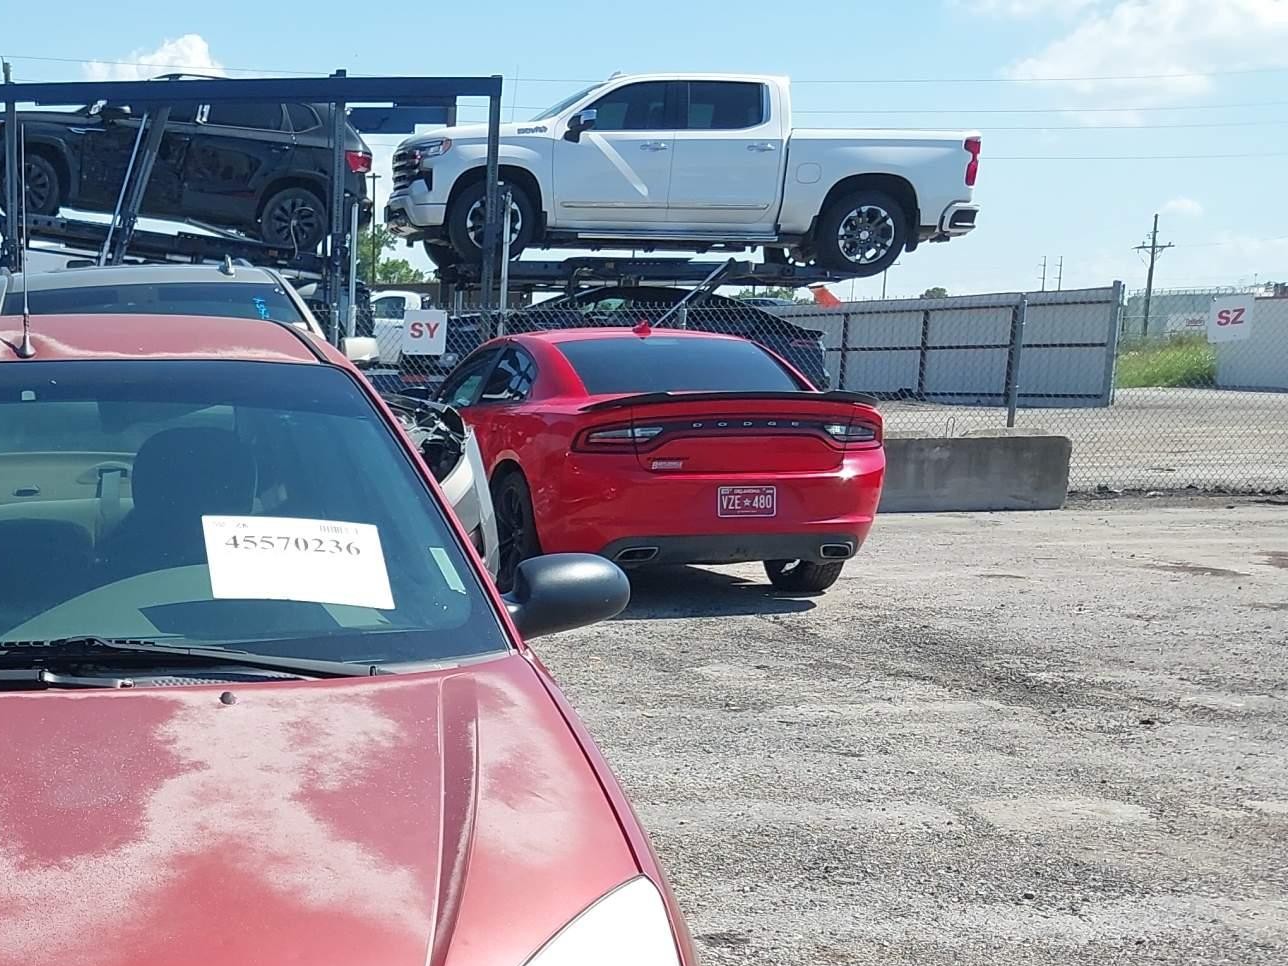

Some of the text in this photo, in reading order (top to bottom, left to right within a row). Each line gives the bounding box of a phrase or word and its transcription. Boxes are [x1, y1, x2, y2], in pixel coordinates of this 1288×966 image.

[1216, 308, 1245, 326] SZ
[410, 322, 440, 338] SY
[722, 494, 773, 509] VZE 480
[224, 535, 361, 556] 45570236
